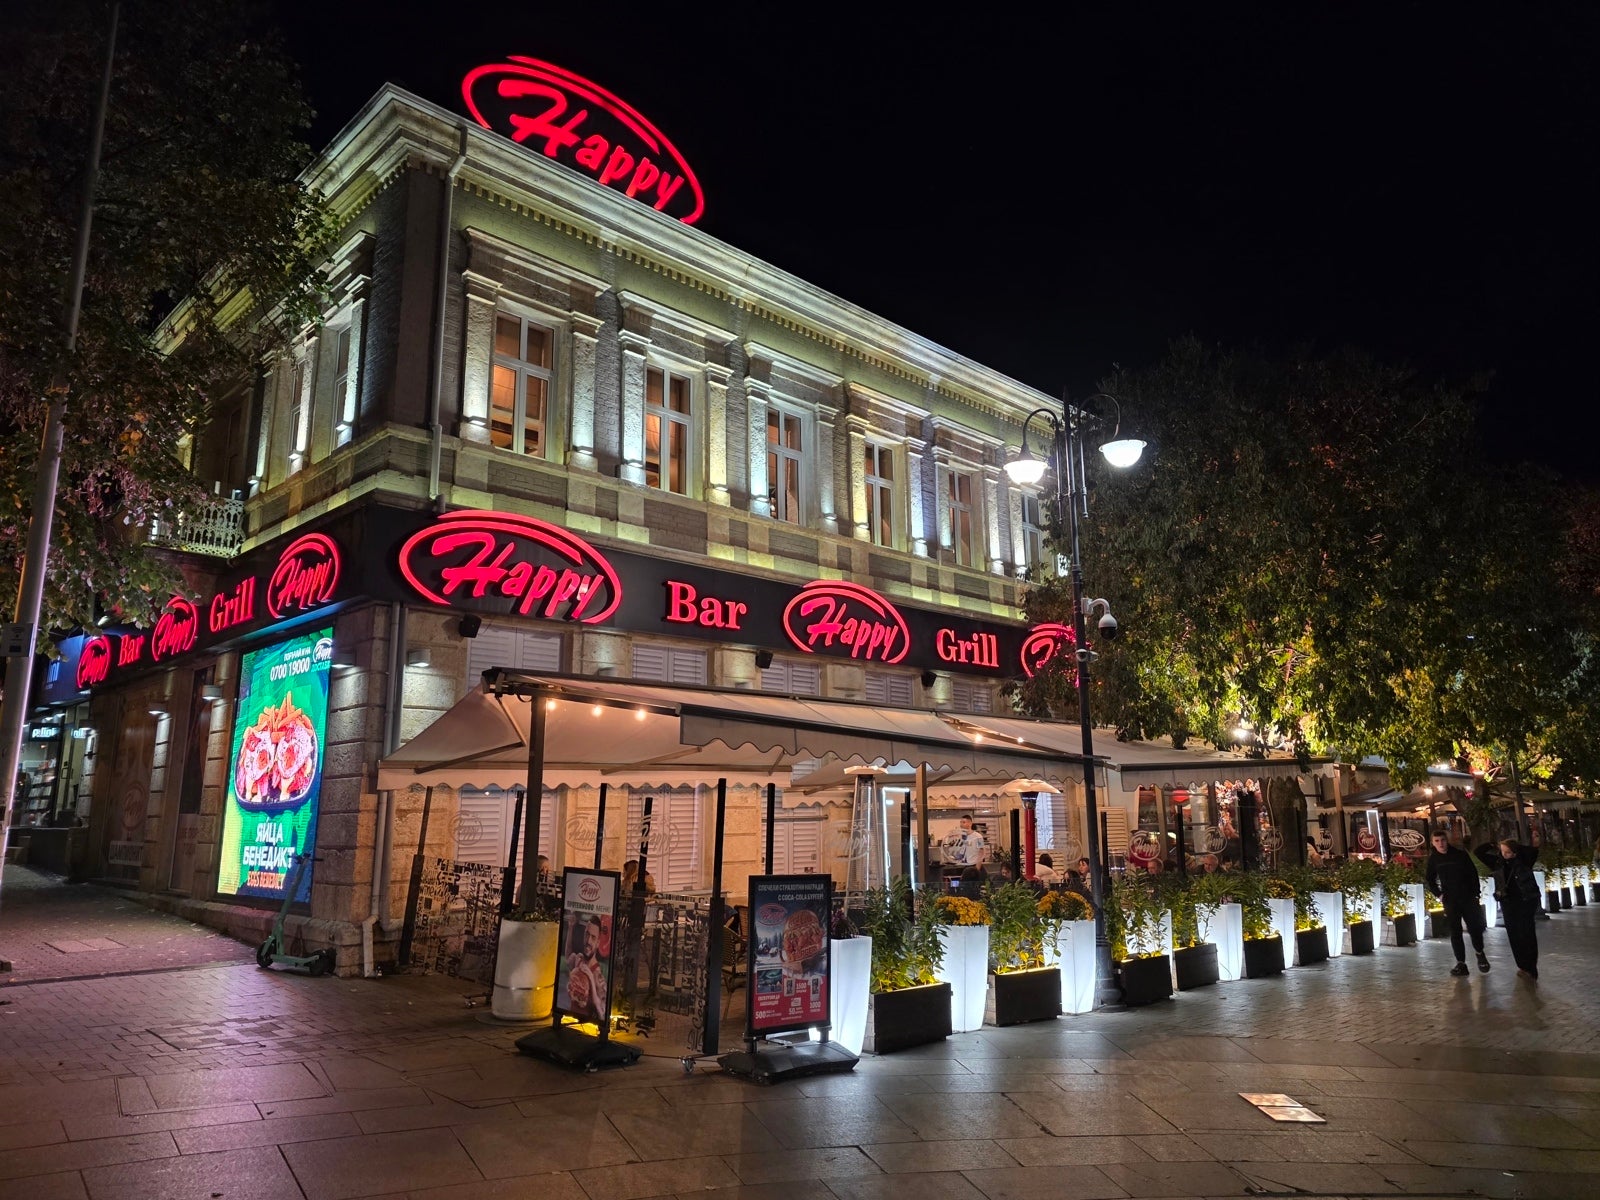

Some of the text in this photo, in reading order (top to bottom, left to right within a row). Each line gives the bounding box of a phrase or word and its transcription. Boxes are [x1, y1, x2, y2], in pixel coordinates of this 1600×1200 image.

[498, 79, 684, 211] Happy
[275, 558, 332, 610] Happy
[430, 531, 604, 619] Happy
[209, 576, 255, 633] Grill
[666, 580, 747, 630] Bar
[118, 634, 145, 667] Bar
[157, 613, 194, 656] Happy
[800, 596, 899, 661] Happy
[936, 628, 1000, 668] Grill
[270, 657, 310, 682] 0700 19000
[256, 817, 284, 846] ЯЙЦА
[243, 845, 296, 871] БЕНЕДИКТ
